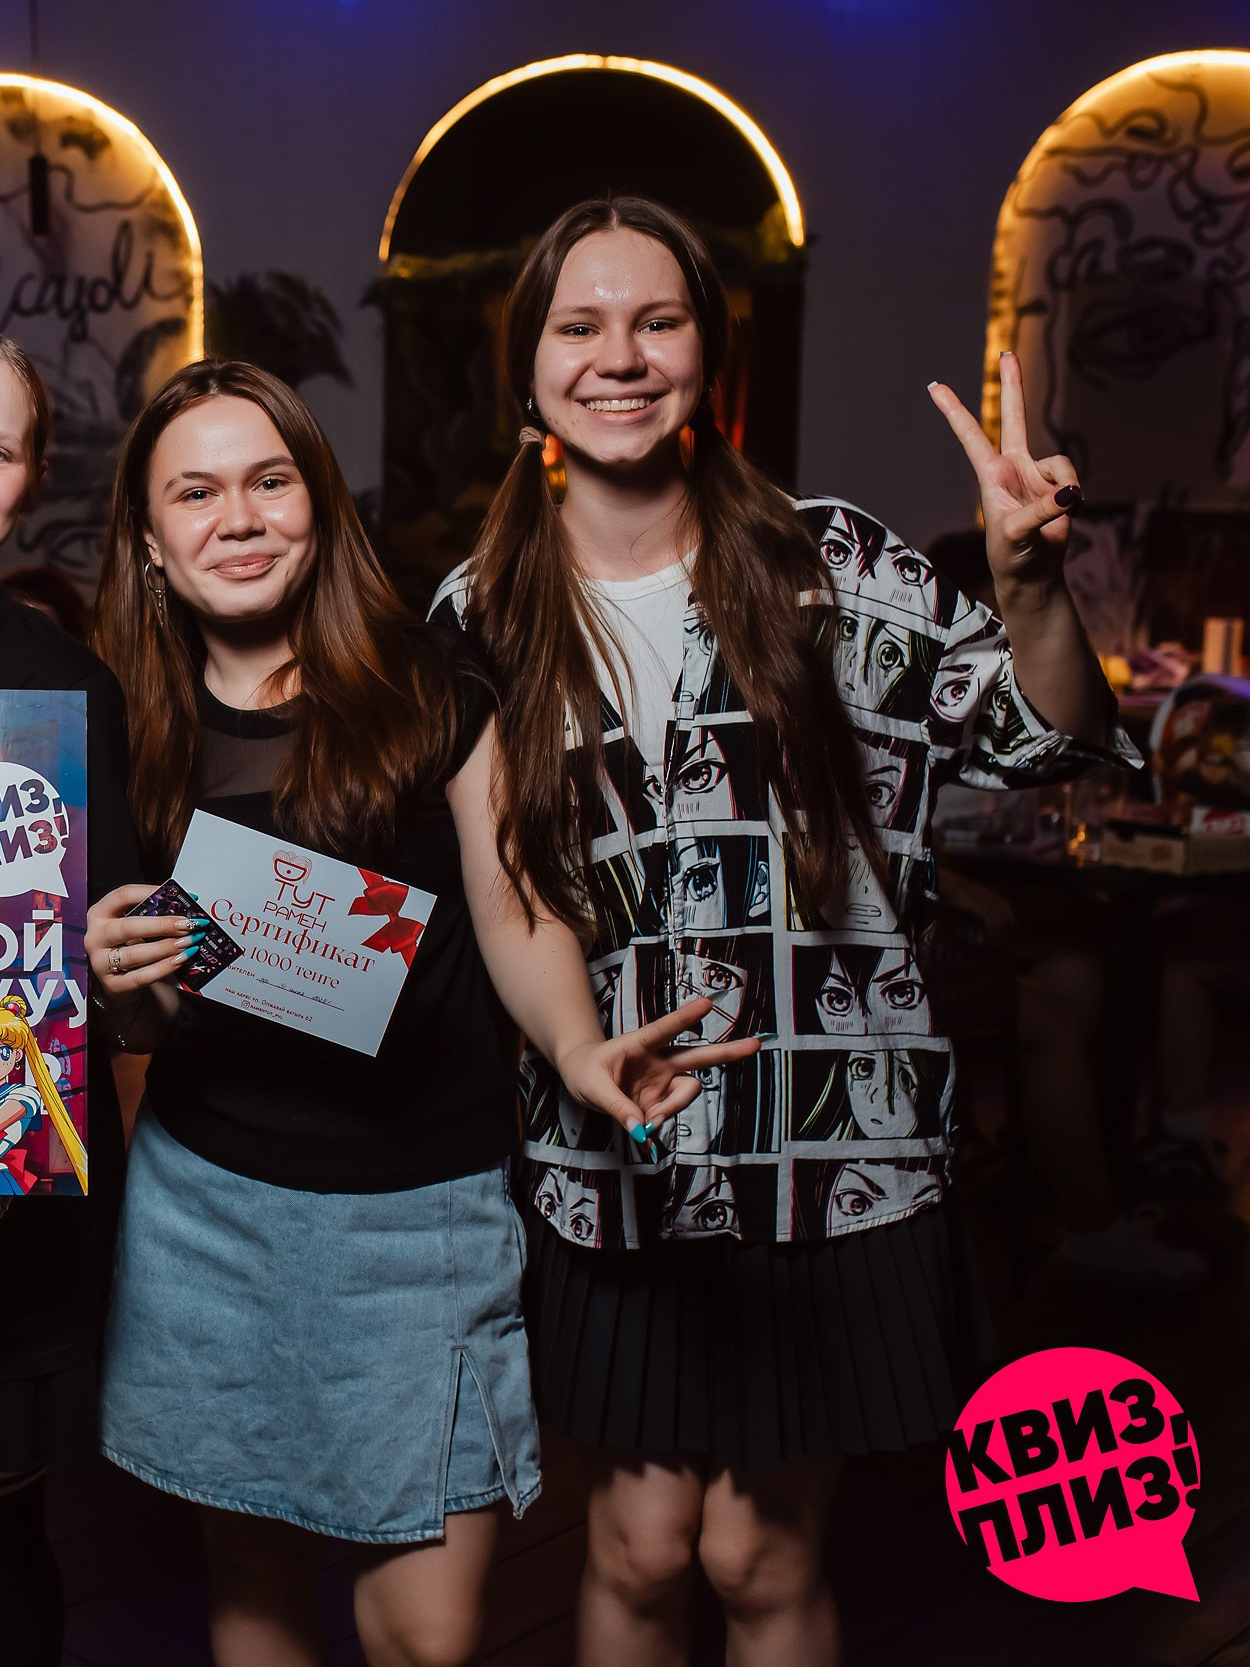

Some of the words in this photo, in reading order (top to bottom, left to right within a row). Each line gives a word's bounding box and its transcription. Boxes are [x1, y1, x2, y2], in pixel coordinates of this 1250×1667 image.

[274, 878, 335, 915] ТУТ
[210, 898, 376, 974] Сертификат
[263, 901, 328, 933] РАМЕН
[250, 946, 292, 972] 1000
[295, 965, 340, 989] тенге
